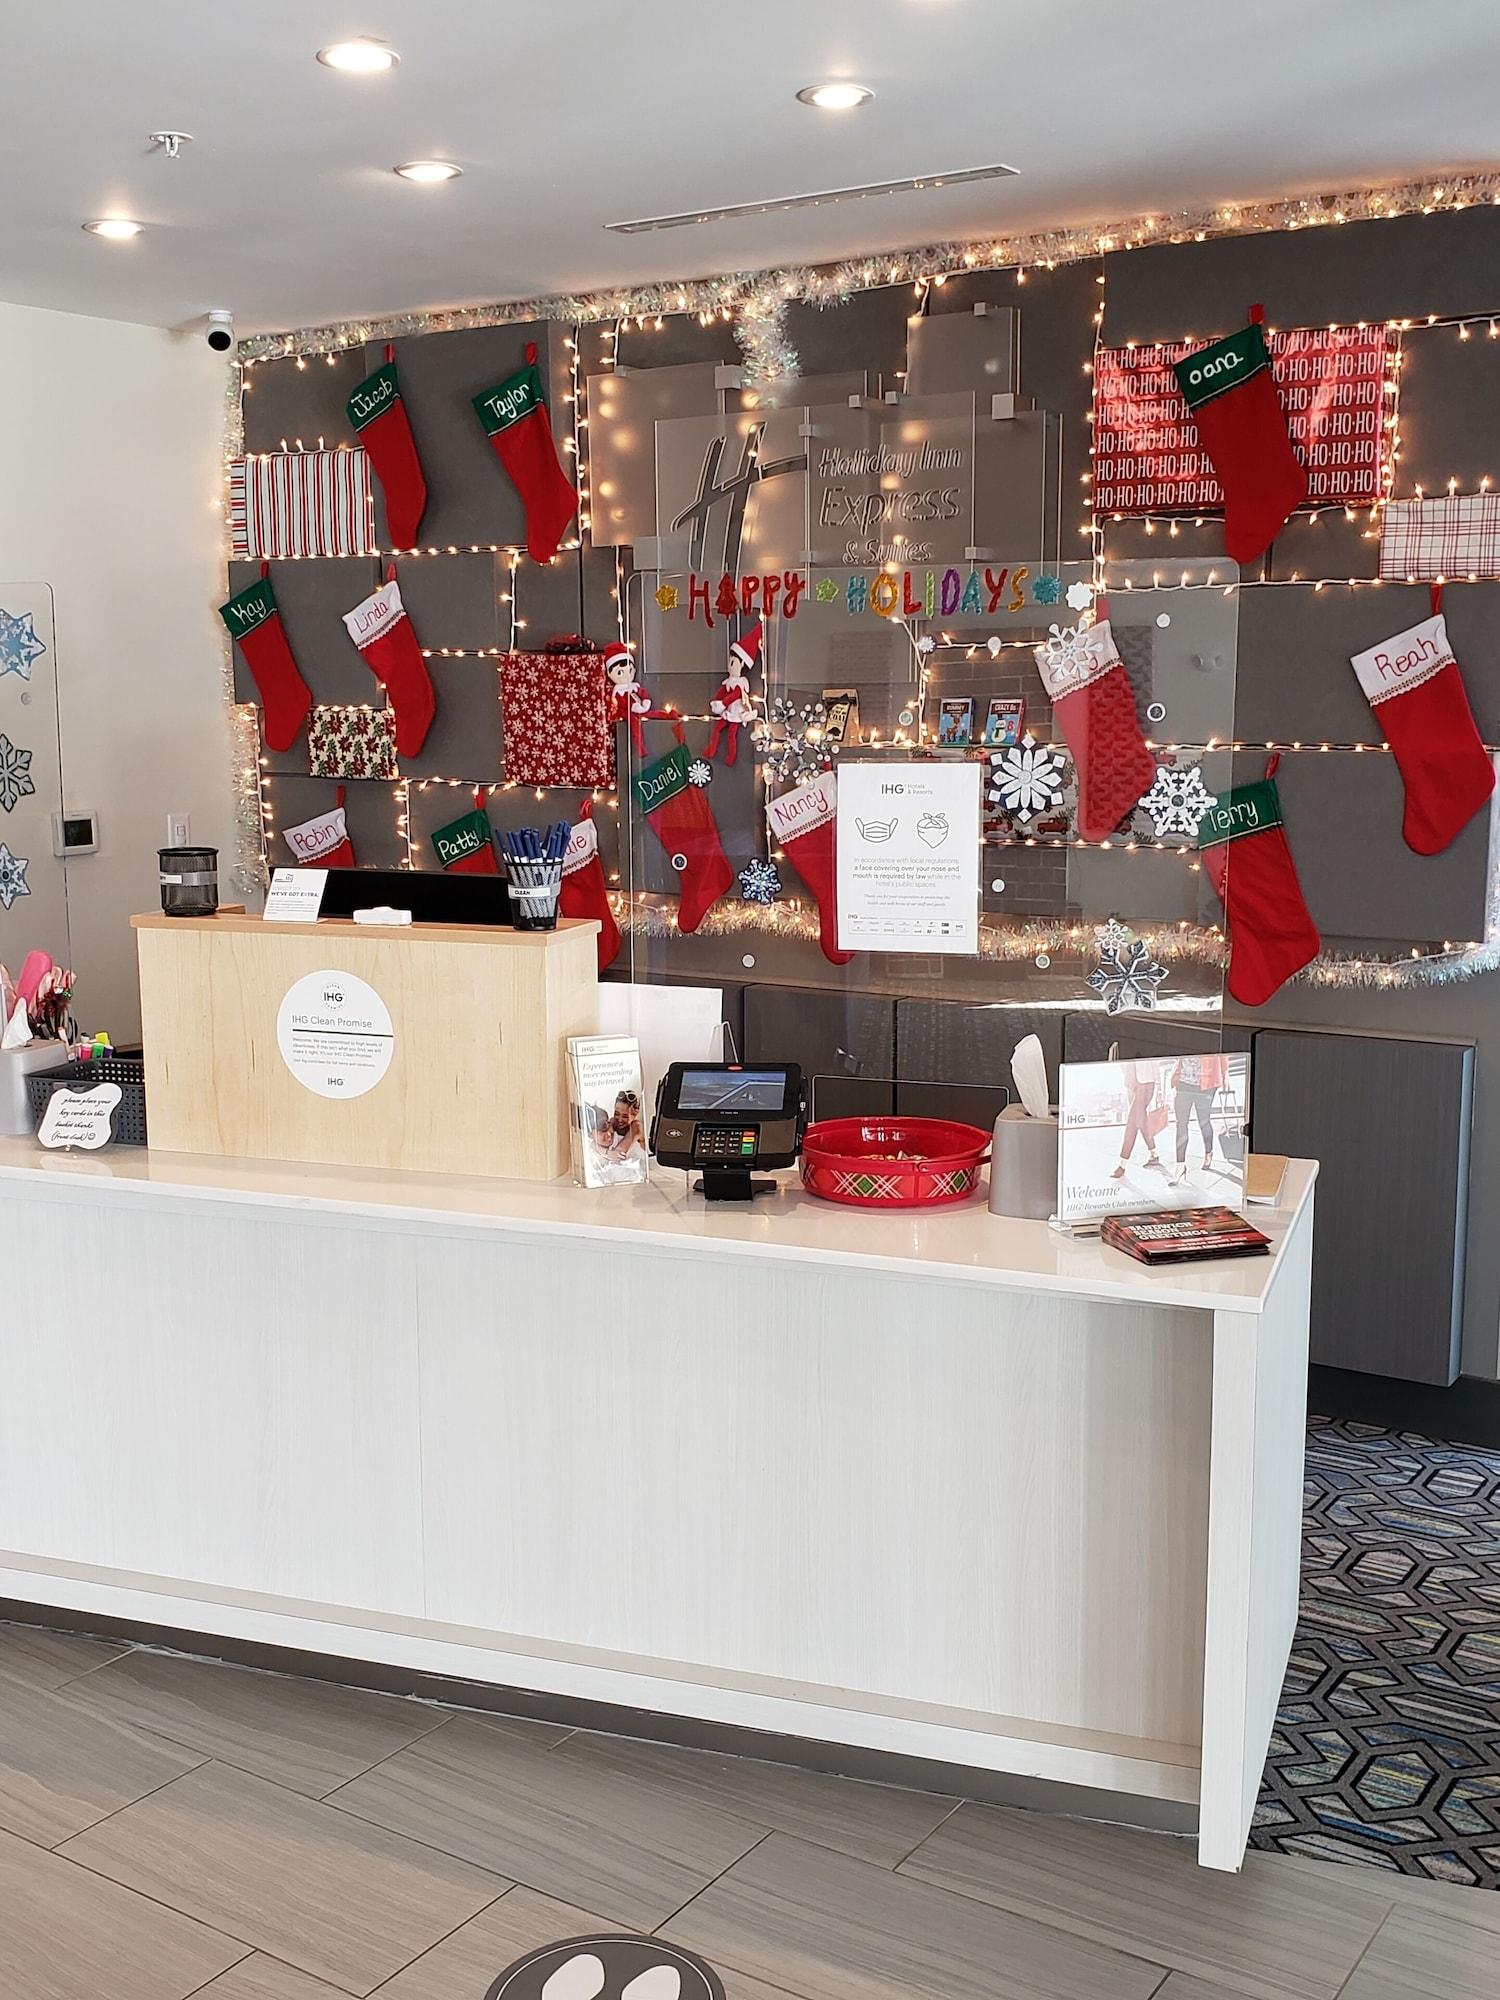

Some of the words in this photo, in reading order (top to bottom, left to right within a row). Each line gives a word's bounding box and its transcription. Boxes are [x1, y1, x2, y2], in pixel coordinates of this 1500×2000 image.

[351, 378, 393, 418] Jacob
[484, 383, 530, 419] Taylor
[819, 443, 917, 479] Holiday
[920, 440, 962, 471] Inn
[819, 486, 961, 537] Express
[842, 543, 859, 564] &
[862, 538, 933, 564] Suites
[846, 567, 1029, 620] HOLIDAYS
[231, 598, 267, 625] Kay
[354, 601, 388, 634] Linda
[1374, 638, 1439, 680] Reah
[638, 758, 682, 801] Daniel
[881, 783, 904, 795] IHG
[774, 788, 828, 826] Nancy
[1205, 801, 1259, 832] Terry
[294, 824, 339, 852] Robin
[438, 829, 480, 860] Patty
[874, 865, 900, 873] covering
[880, 873, 905, 881] required
[324, 992, 343, 1002] IHG
[292, 1015, 308, 1024] IHG
[311, 1016, 335, 1026] Clean
[337, 1018, 372, 1029] Promise
[583, 1062, 619, 1071] Experience
[600, 1069, 633, 1077] rewarding
[327, 1077, 344, 1086] IHG
[584, 1080, 596, 1088] way
[606, 1076, 624, 1086] travel
[1067, 1114, 1086, 1124] IHG
[1067, 1185, 1120, 1199] Welcome
[1085, 1202, 1111, 1211] Rewards
[1112, 1200, 1127, 1209] Club
[1128, 1222, 1194, 1231] SANDWICH
[1132, 1228, 1179, 1236] SEASON
[1139, 1230, 1208, 1240] GREETINGS
